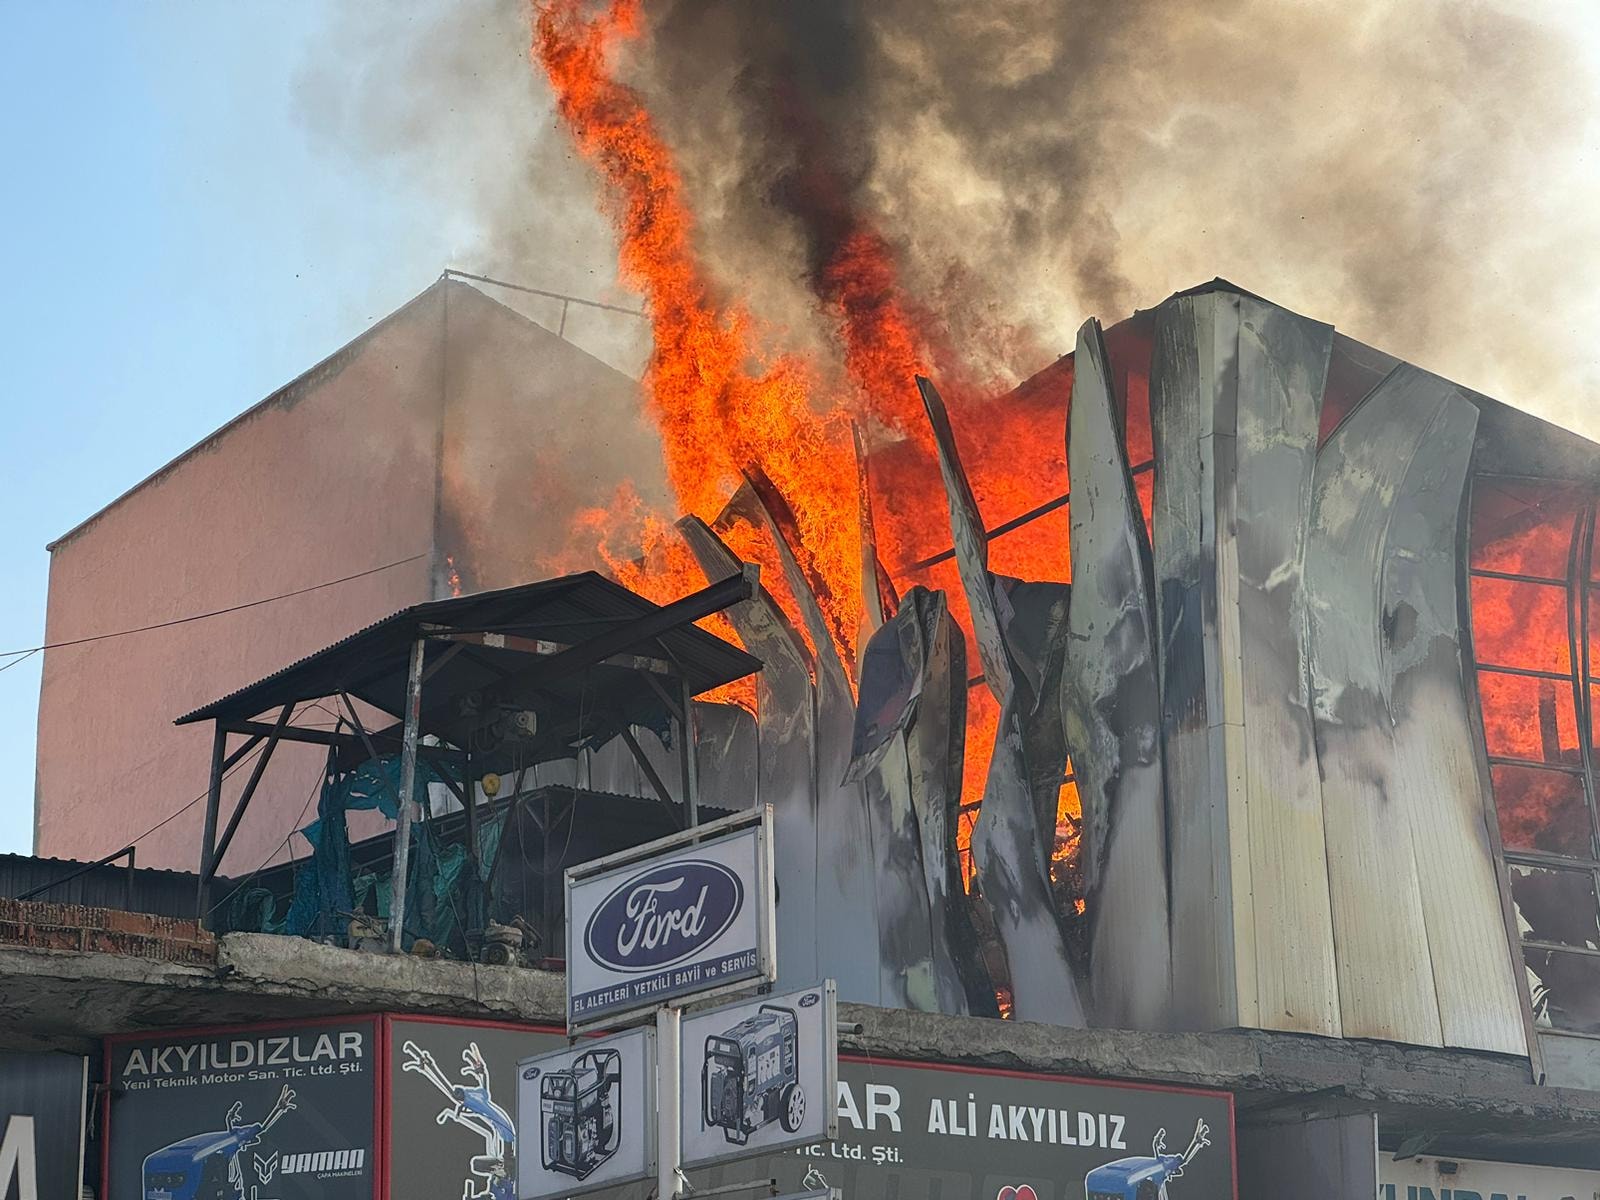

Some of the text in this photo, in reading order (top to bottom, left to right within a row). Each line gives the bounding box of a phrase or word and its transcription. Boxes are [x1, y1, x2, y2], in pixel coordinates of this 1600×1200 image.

[617, 876, 709, 957] Ford
[574, 1000, 585, 1012] EL
[586, 984, 629, 1009] ALETLERİ
[633, 972, 671, 996] YETKİLİ
[705, 966, 717, 978] ve
[721, 952, 756, 973] SERVİS
[123, 1031, 363, 1076] AKYILDIZLAR
[123, 1062, 363, 1090] Yeni Teknik Motor San. Tic. Ltd. Şti.
[927, 1092, 977, 1137] ALİ
[988, 1104, 1127, 1150] AKYILDIZ
[281, 1149, 365, 1174] YAMAN
[831, 1142, 867, 1160] Ltd.
[871, 1146, 904, 1165] Şti.
